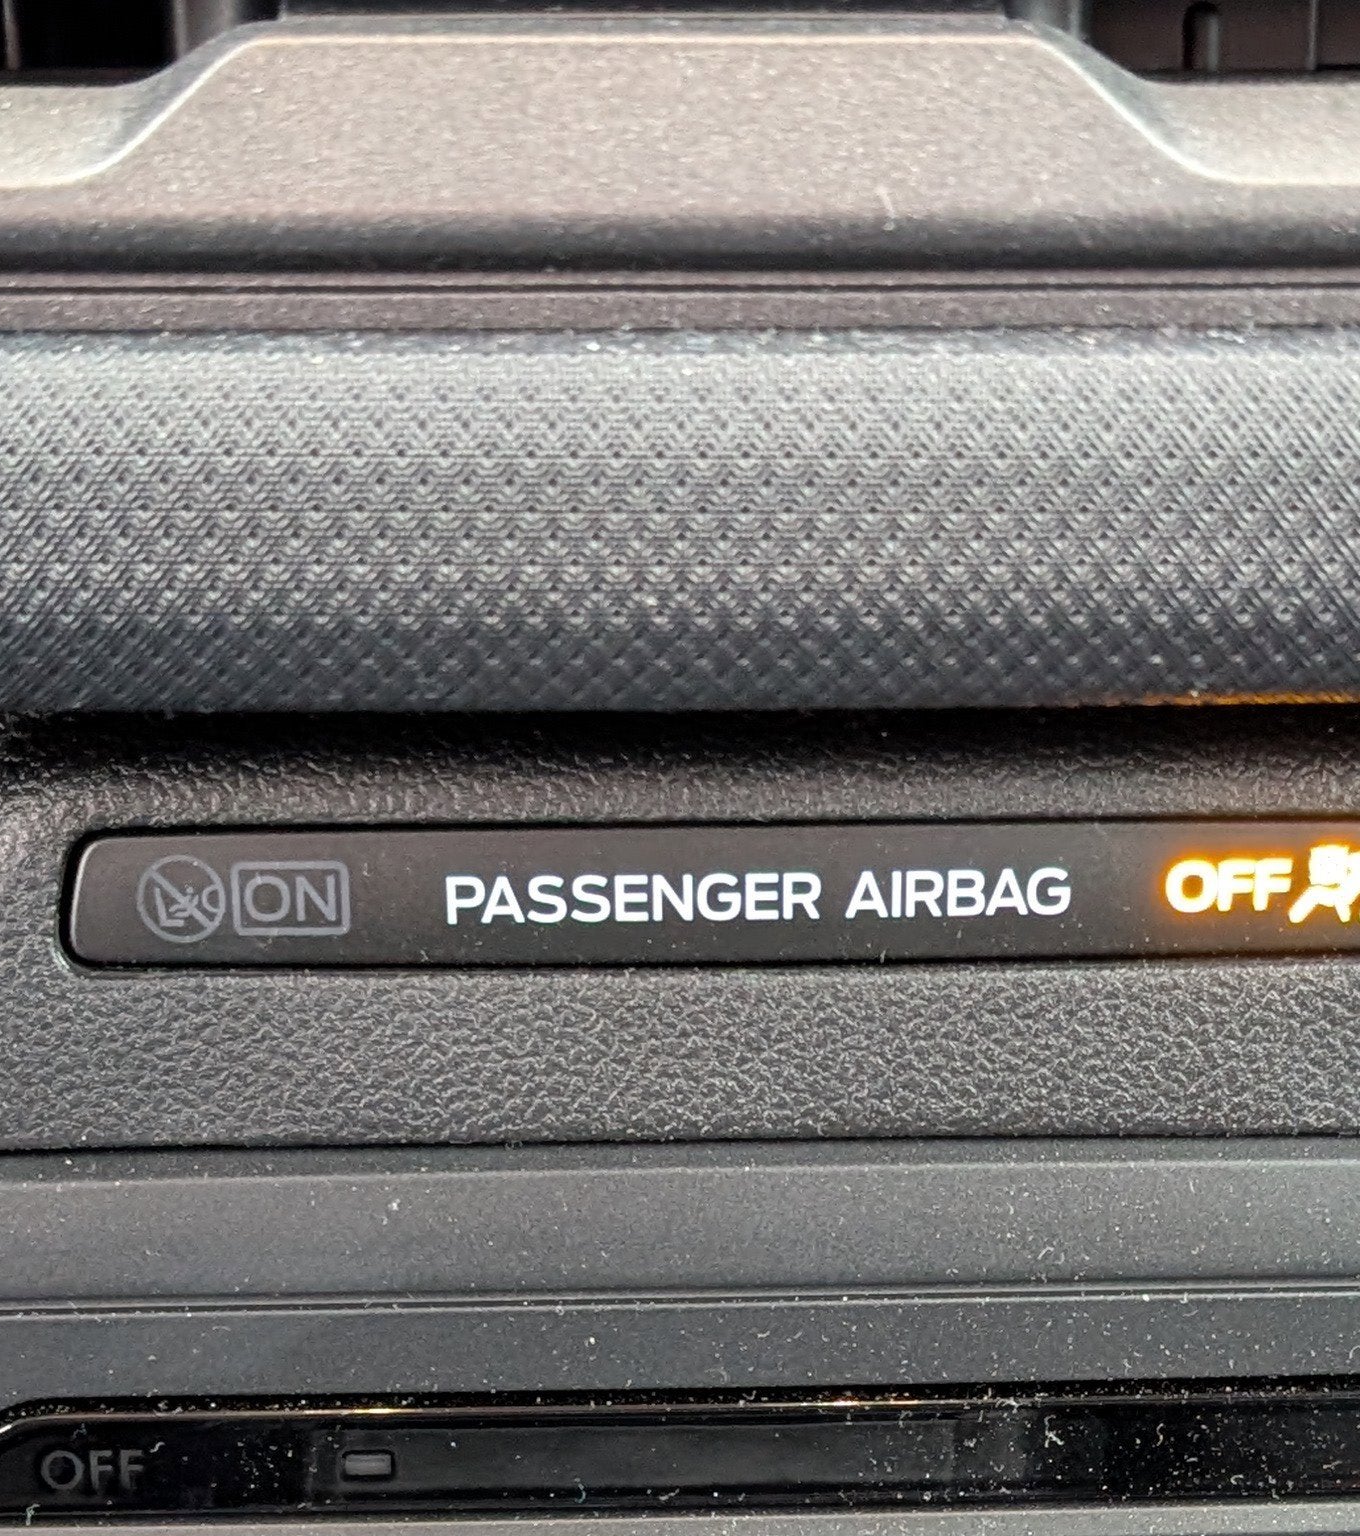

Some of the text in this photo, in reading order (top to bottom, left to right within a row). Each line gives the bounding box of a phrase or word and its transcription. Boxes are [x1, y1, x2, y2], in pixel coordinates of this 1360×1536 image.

[243, 874, 337, 923] ON
[444, 867, 1072, 926] PASSENGER AIRBAG
[1164, 857, 1294, 913] OFF
[40, 1448, 145, 1491] OFF
